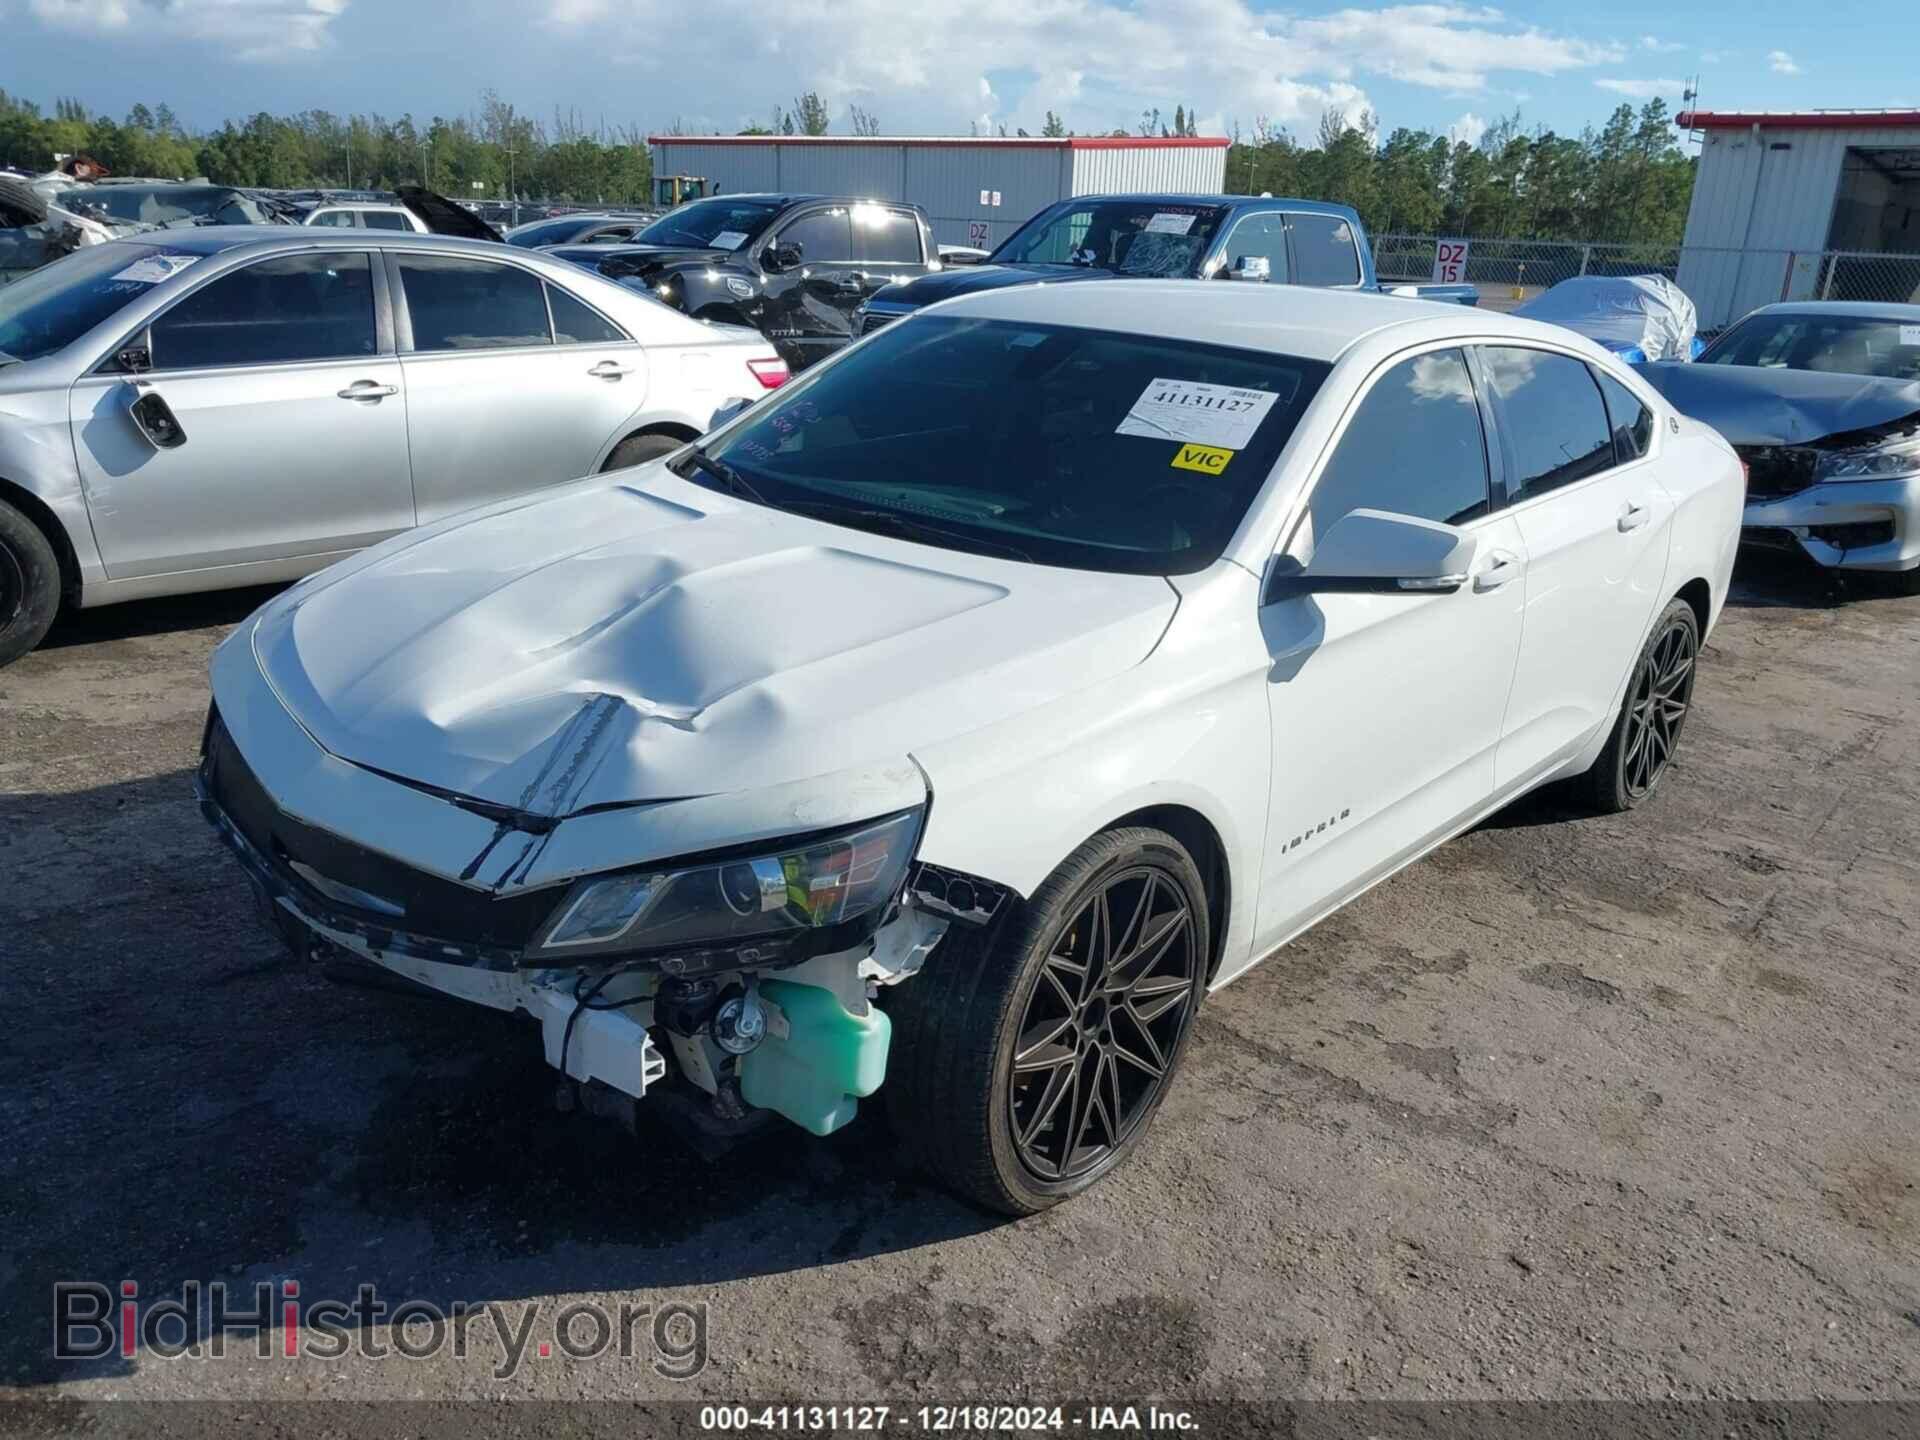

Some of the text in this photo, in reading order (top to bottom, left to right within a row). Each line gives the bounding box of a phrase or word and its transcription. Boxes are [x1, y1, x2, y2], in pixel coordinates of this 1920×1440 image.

[970, 223, 988, 239] DZ
[1439, 244, 1465, 263] DZ
[1441, 265, 1457, 282] 15
[1153, 391, 1255, 413] 41131127
[1183, 449, 1224, 468] VIC
